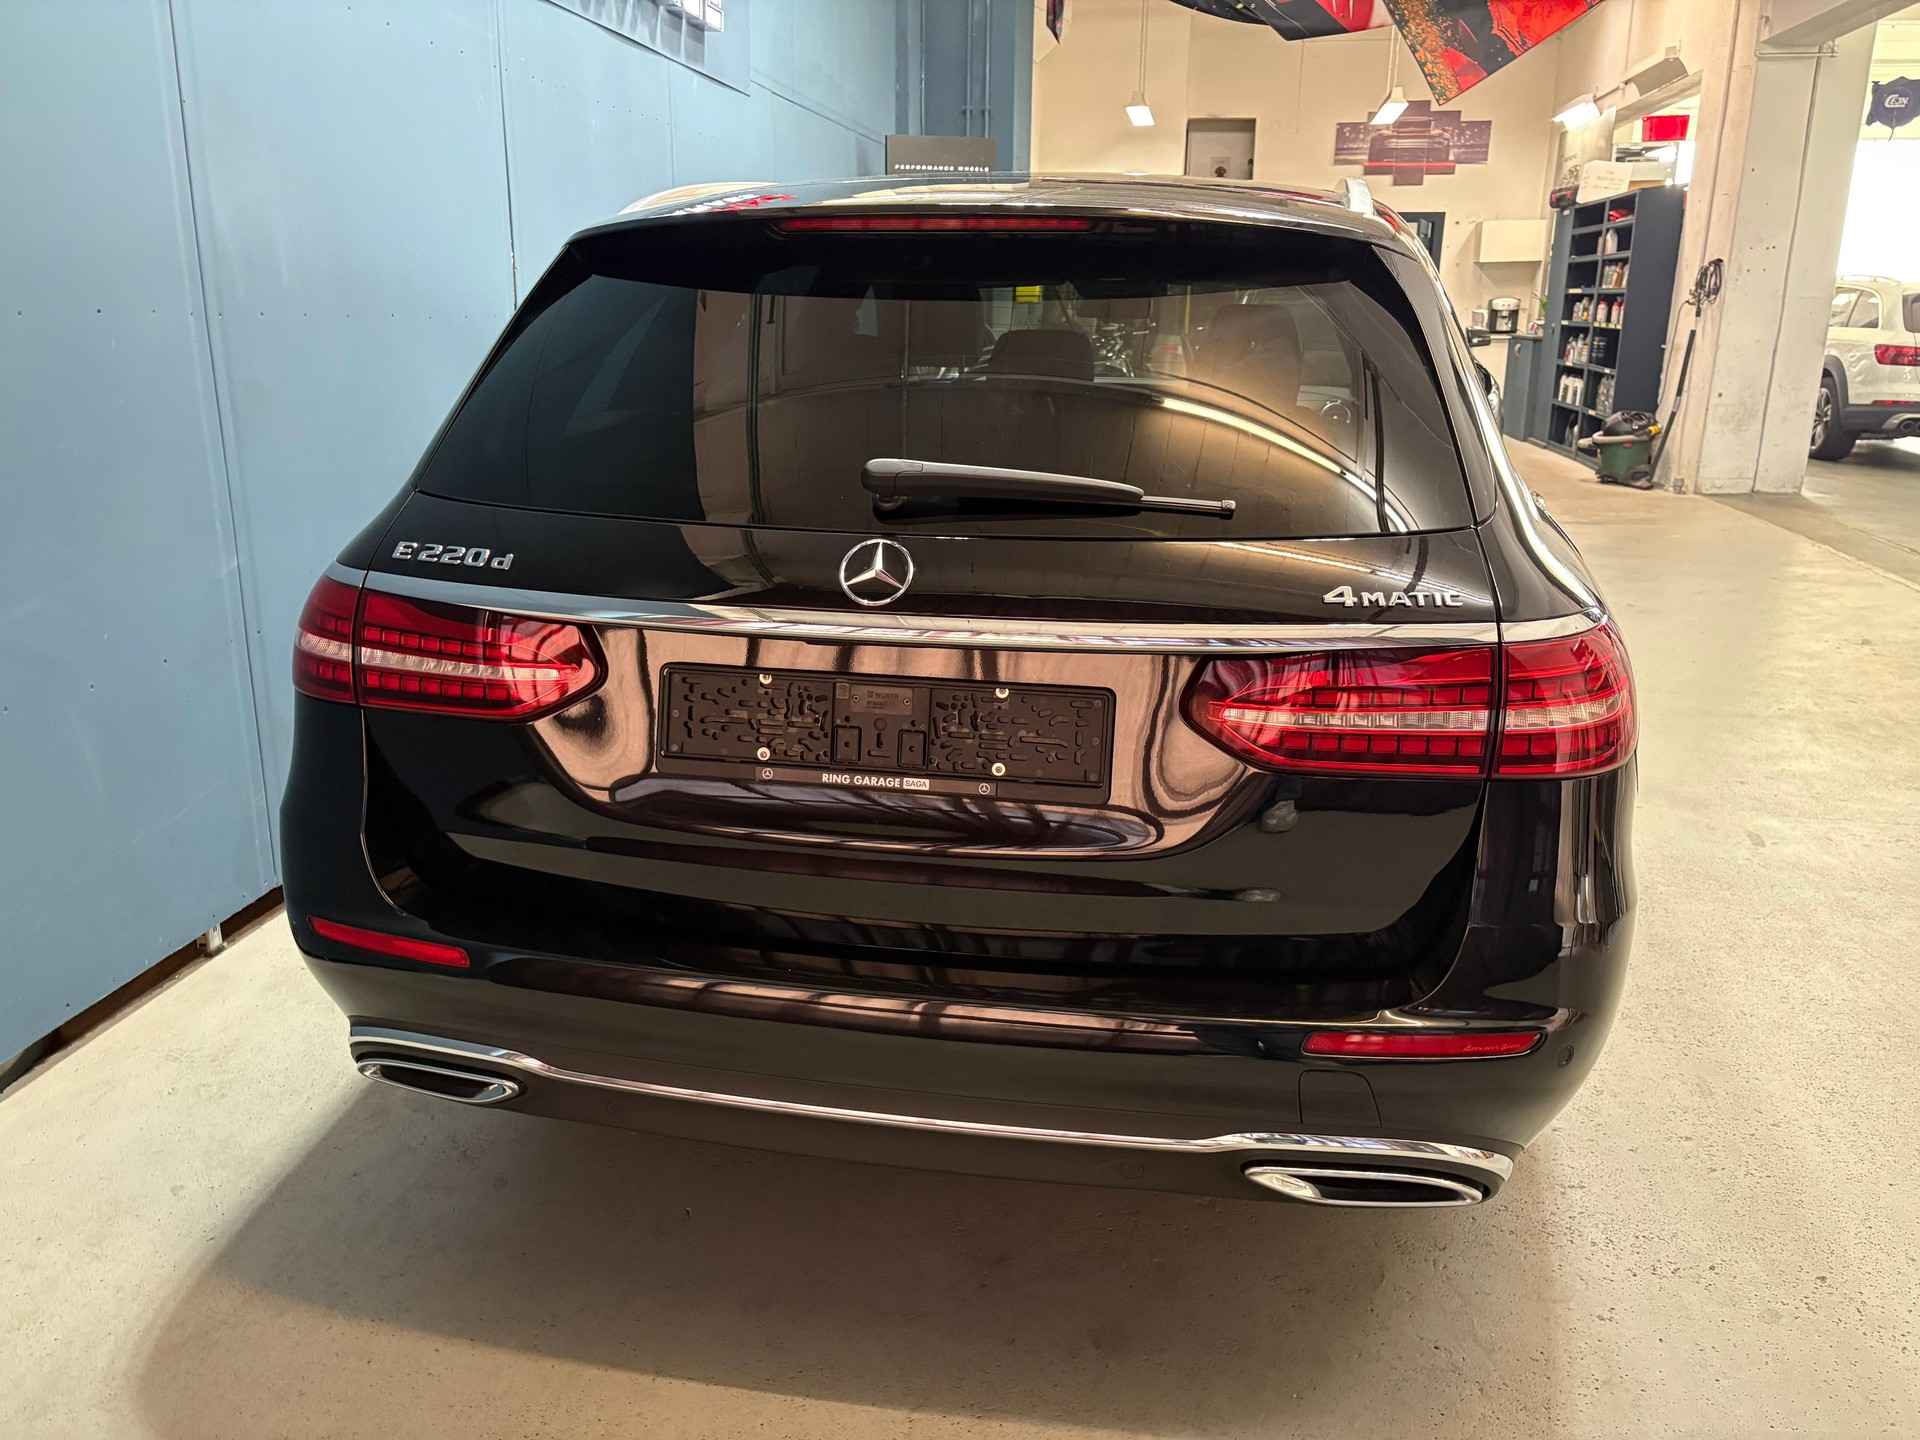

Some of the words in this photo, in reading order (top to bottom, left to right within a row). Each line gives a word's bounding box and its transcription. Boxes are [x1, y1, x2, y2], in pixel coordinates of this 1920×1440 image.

[894, 163, 955, 171] PERFORMANCE
[1323, 585, 1464, 607] 4MATIC
[822, 773, 851, 785] RING
[853, 775, 901, 788] GARAGE
[904, 779, 928, 789] SAGA
